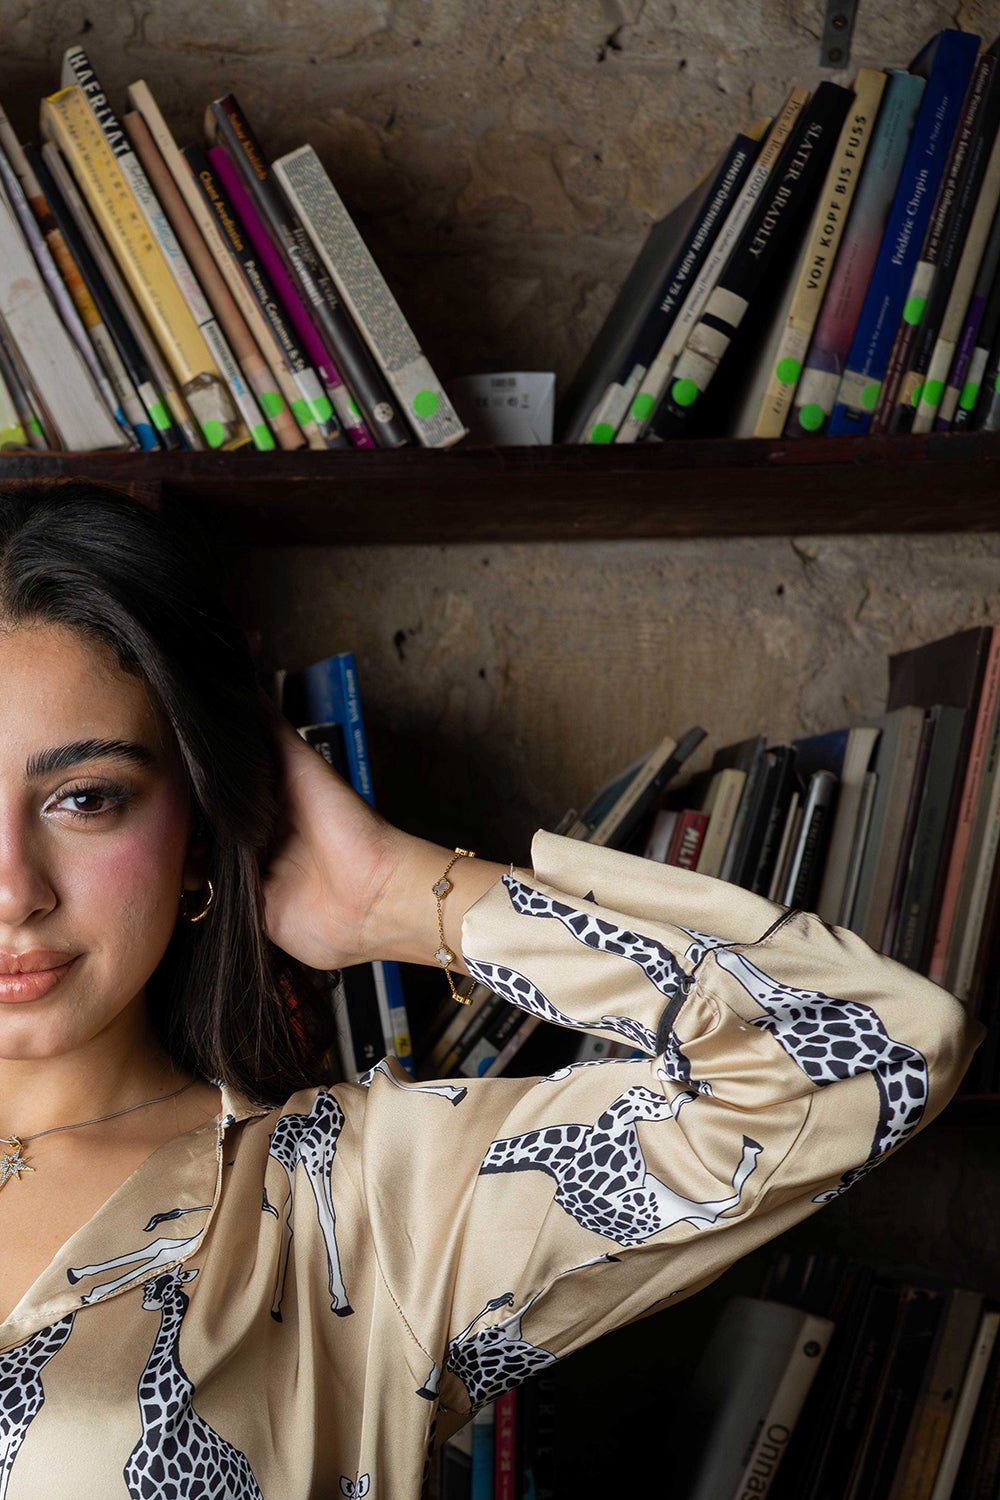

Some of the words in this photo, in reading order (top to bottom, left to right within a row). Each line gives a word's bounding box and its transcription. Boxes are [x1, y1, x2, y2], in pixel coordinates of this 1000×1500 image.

[774, 120, 792, 138] de
[781, 120, 826, 187] SLATER
[842, 112, 869, 159] FUSS
[688, 149, 749, 252] KONSTFÖRENINGEN
[744, 165, 769, 200] 2004
[833, 164, 854, 195] BIS
[744, 184, 793, 260] BRADLEY
[817, 198, 845, 249] KOPF
[889, 215, 916, 267] Frédéric
[904, 166, 932, 218] Chopin
[210, 197, 248, 254] Avedissian
[241, 257, 274, 305] Patterns,
[262, 300, 296, 352] Costumes
[286, 348, 300, 362] &
[674, 248, 699, 282] AURA
[805, 253, 828, 291] VON
[657, 293, 678, 315] ÅR
[536, 1378, 557, 1458] URIE
